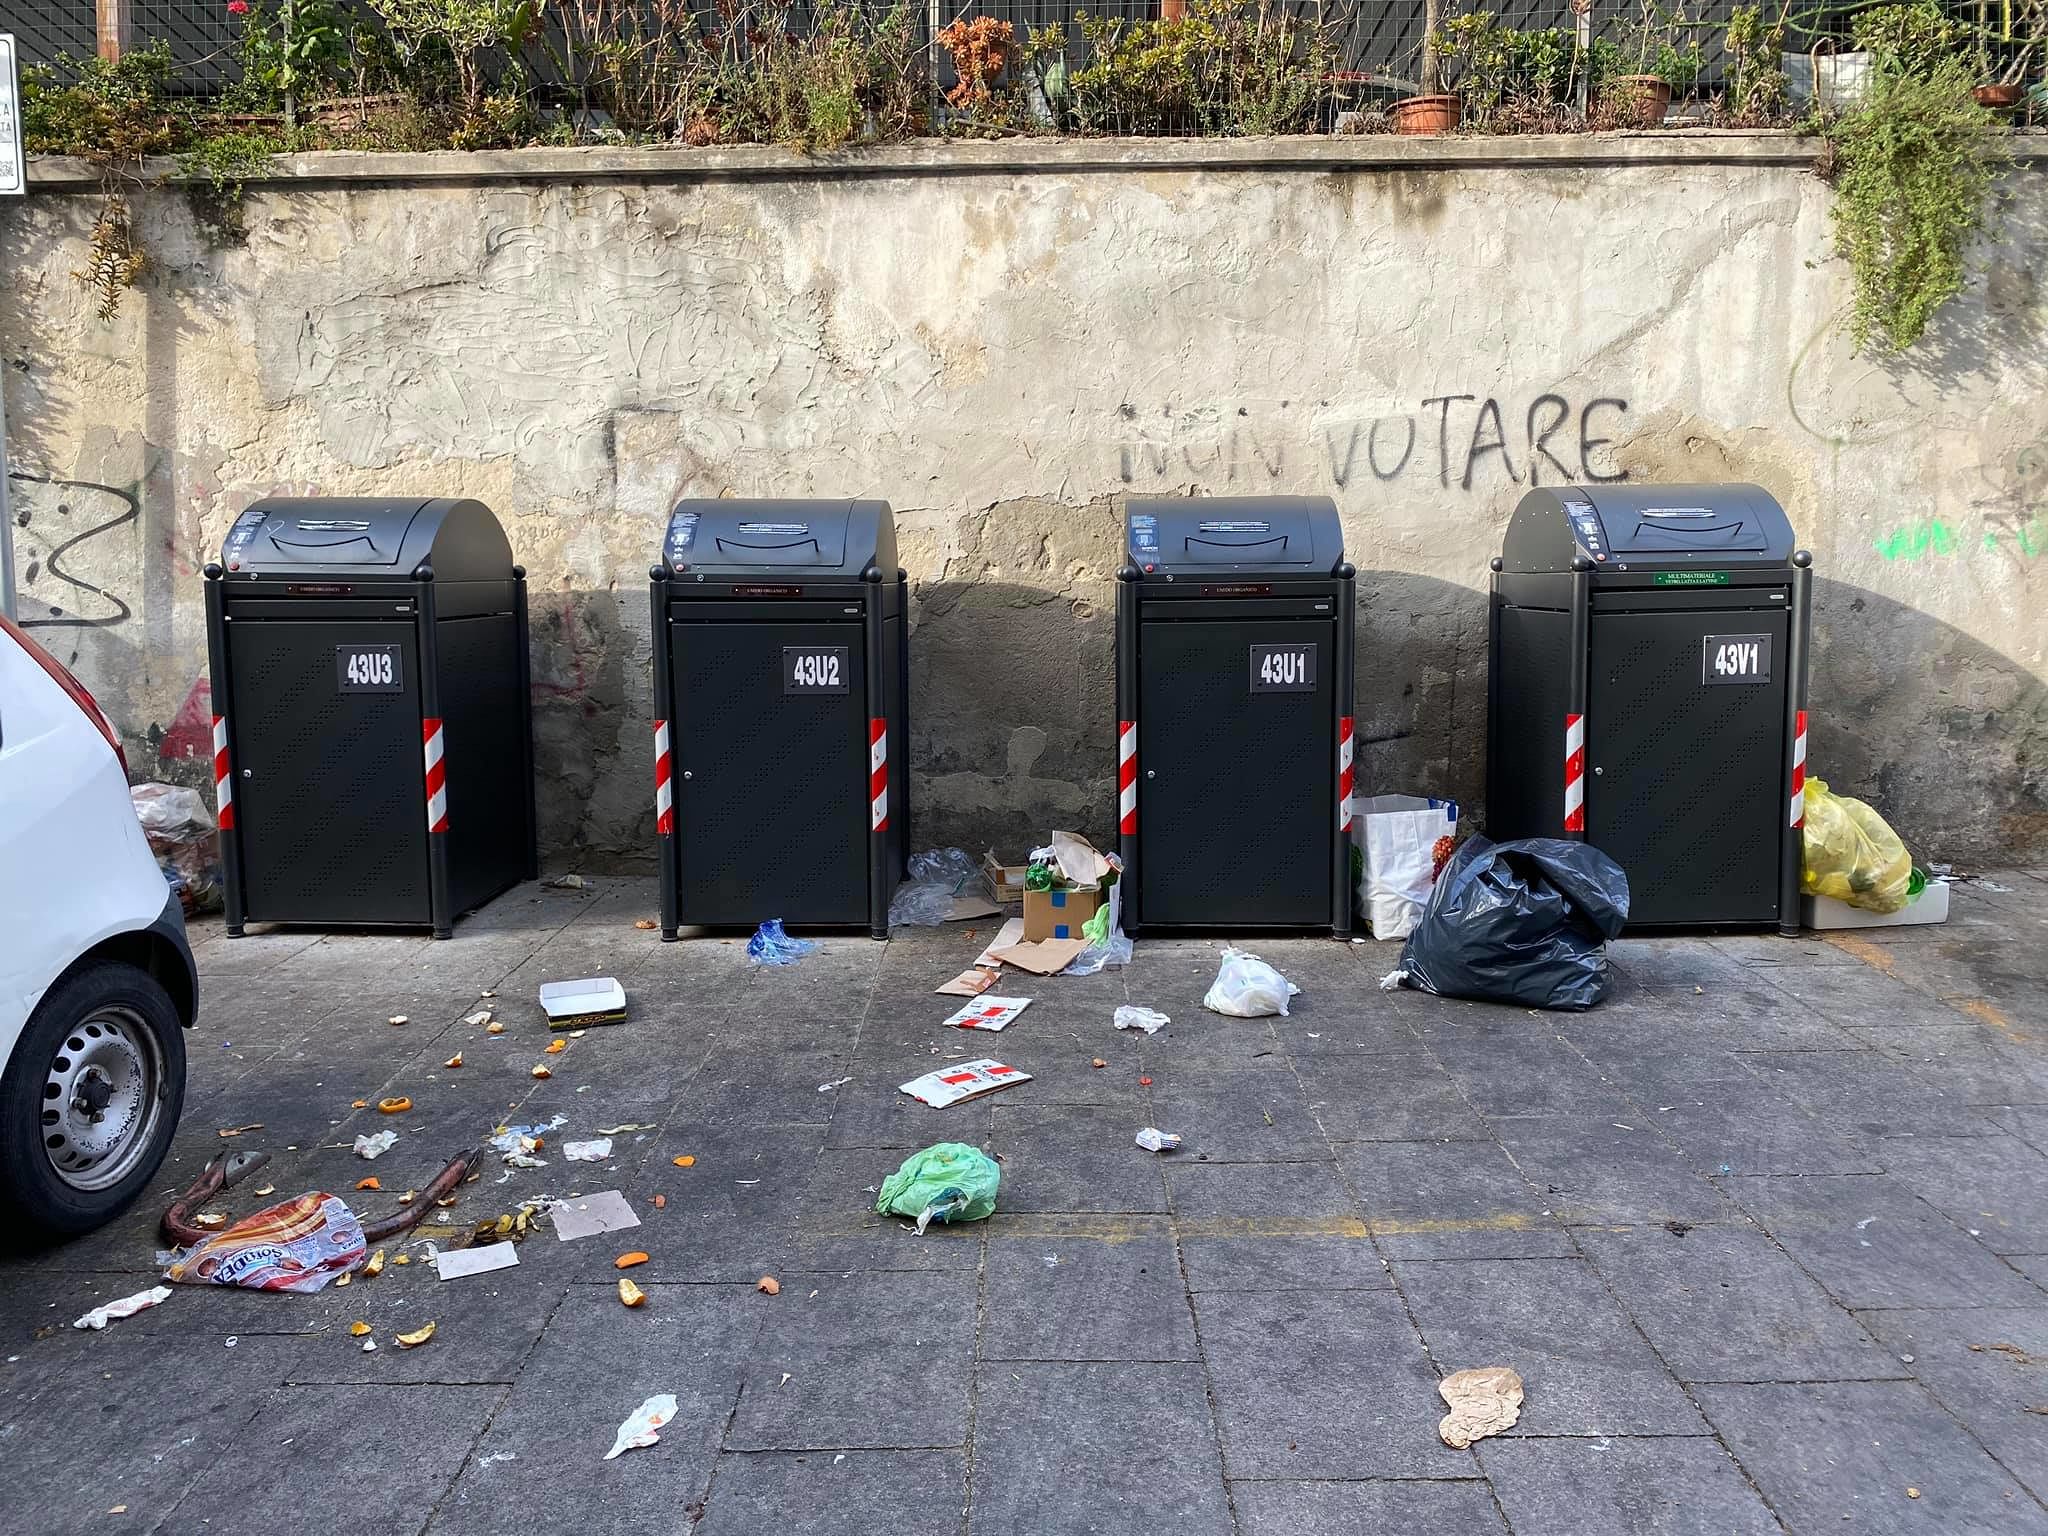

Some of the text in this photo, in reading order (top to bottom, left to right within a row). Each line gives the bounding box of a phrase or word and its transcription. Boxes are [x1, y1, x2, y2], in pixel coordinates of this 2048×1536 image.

[1320, 394, 1629, 490] VOTARE
[347, 653, 393, 684] 43U3
[794, 655, 840, 686] 43U2
[1261, 653, 1305, 684] 43U1
[1715, 643, 1758, 675] 43V1
